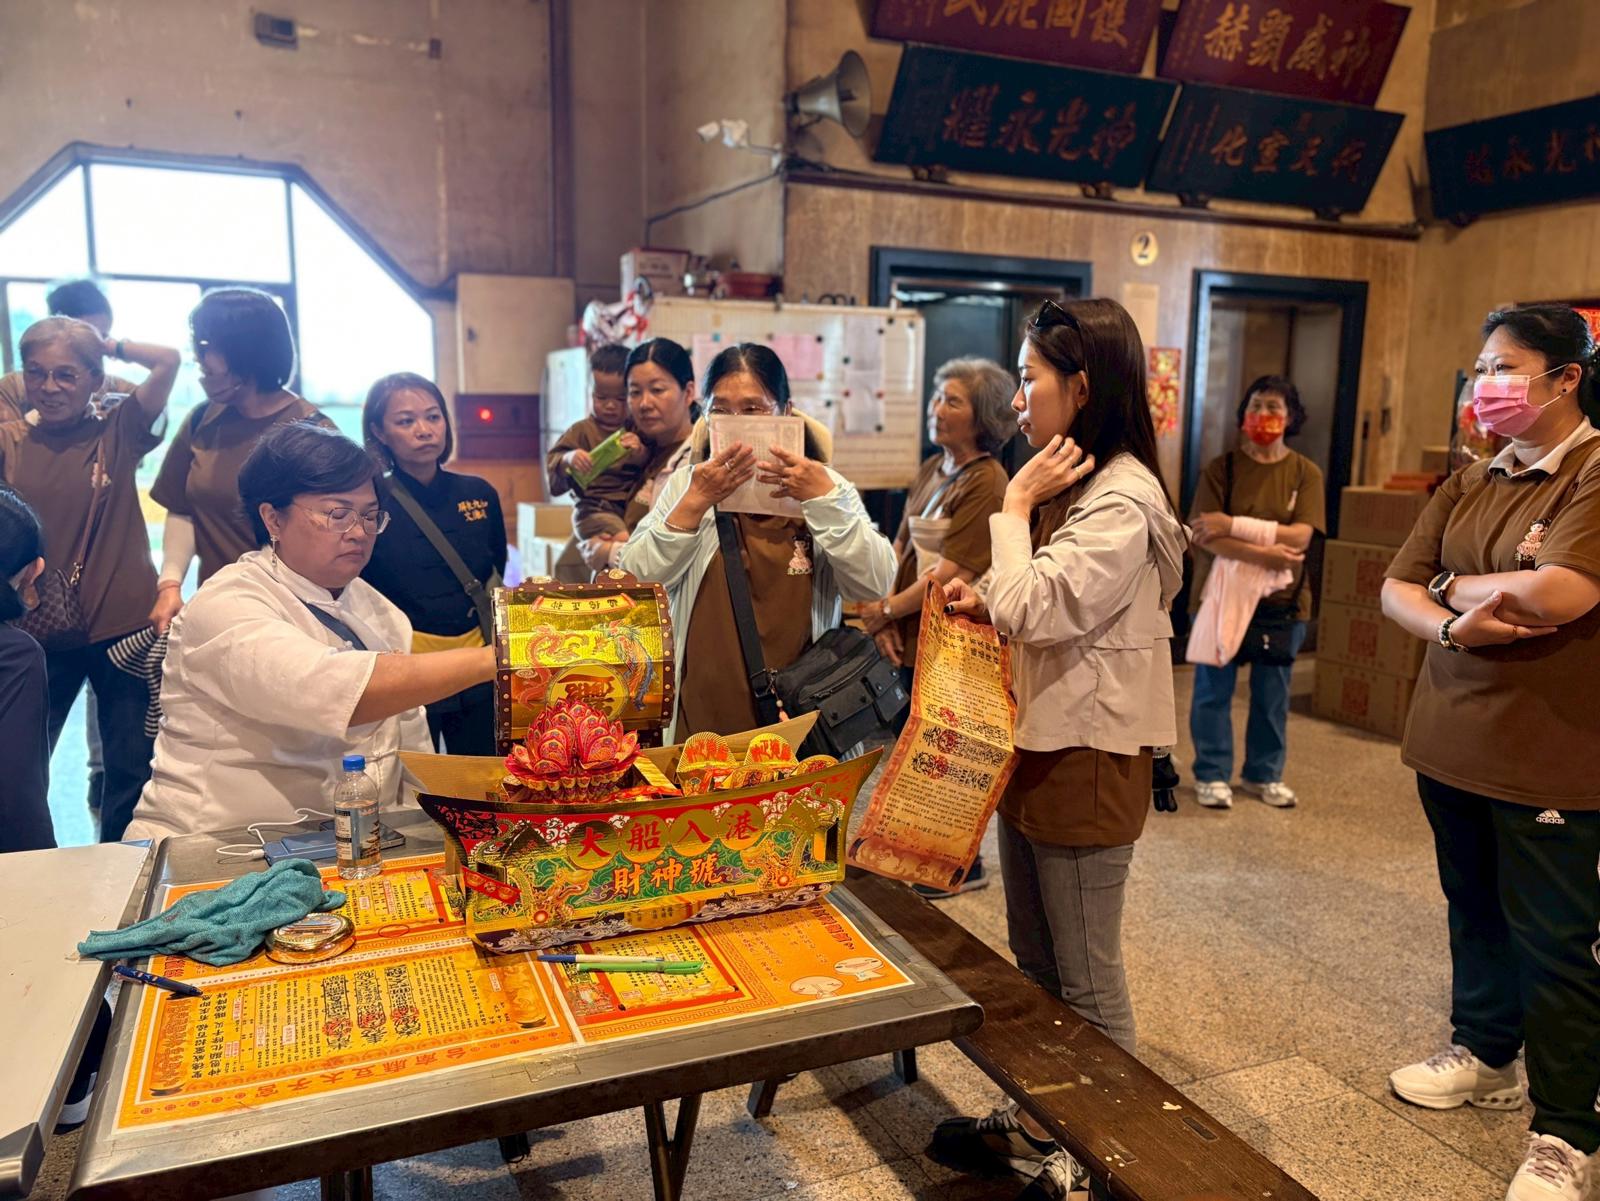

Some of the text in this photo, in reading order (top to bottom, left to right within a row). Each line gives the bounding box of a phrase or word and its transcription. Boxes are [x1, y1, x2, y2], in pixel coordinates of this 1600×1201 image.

[1137, 235, 1150, 259] 2
[577, 810, 759, 858] 大船入港
[612, 852, 723, 895] 財神號
[255, 1046, 466, 1098] 台南麻豆太子宮
